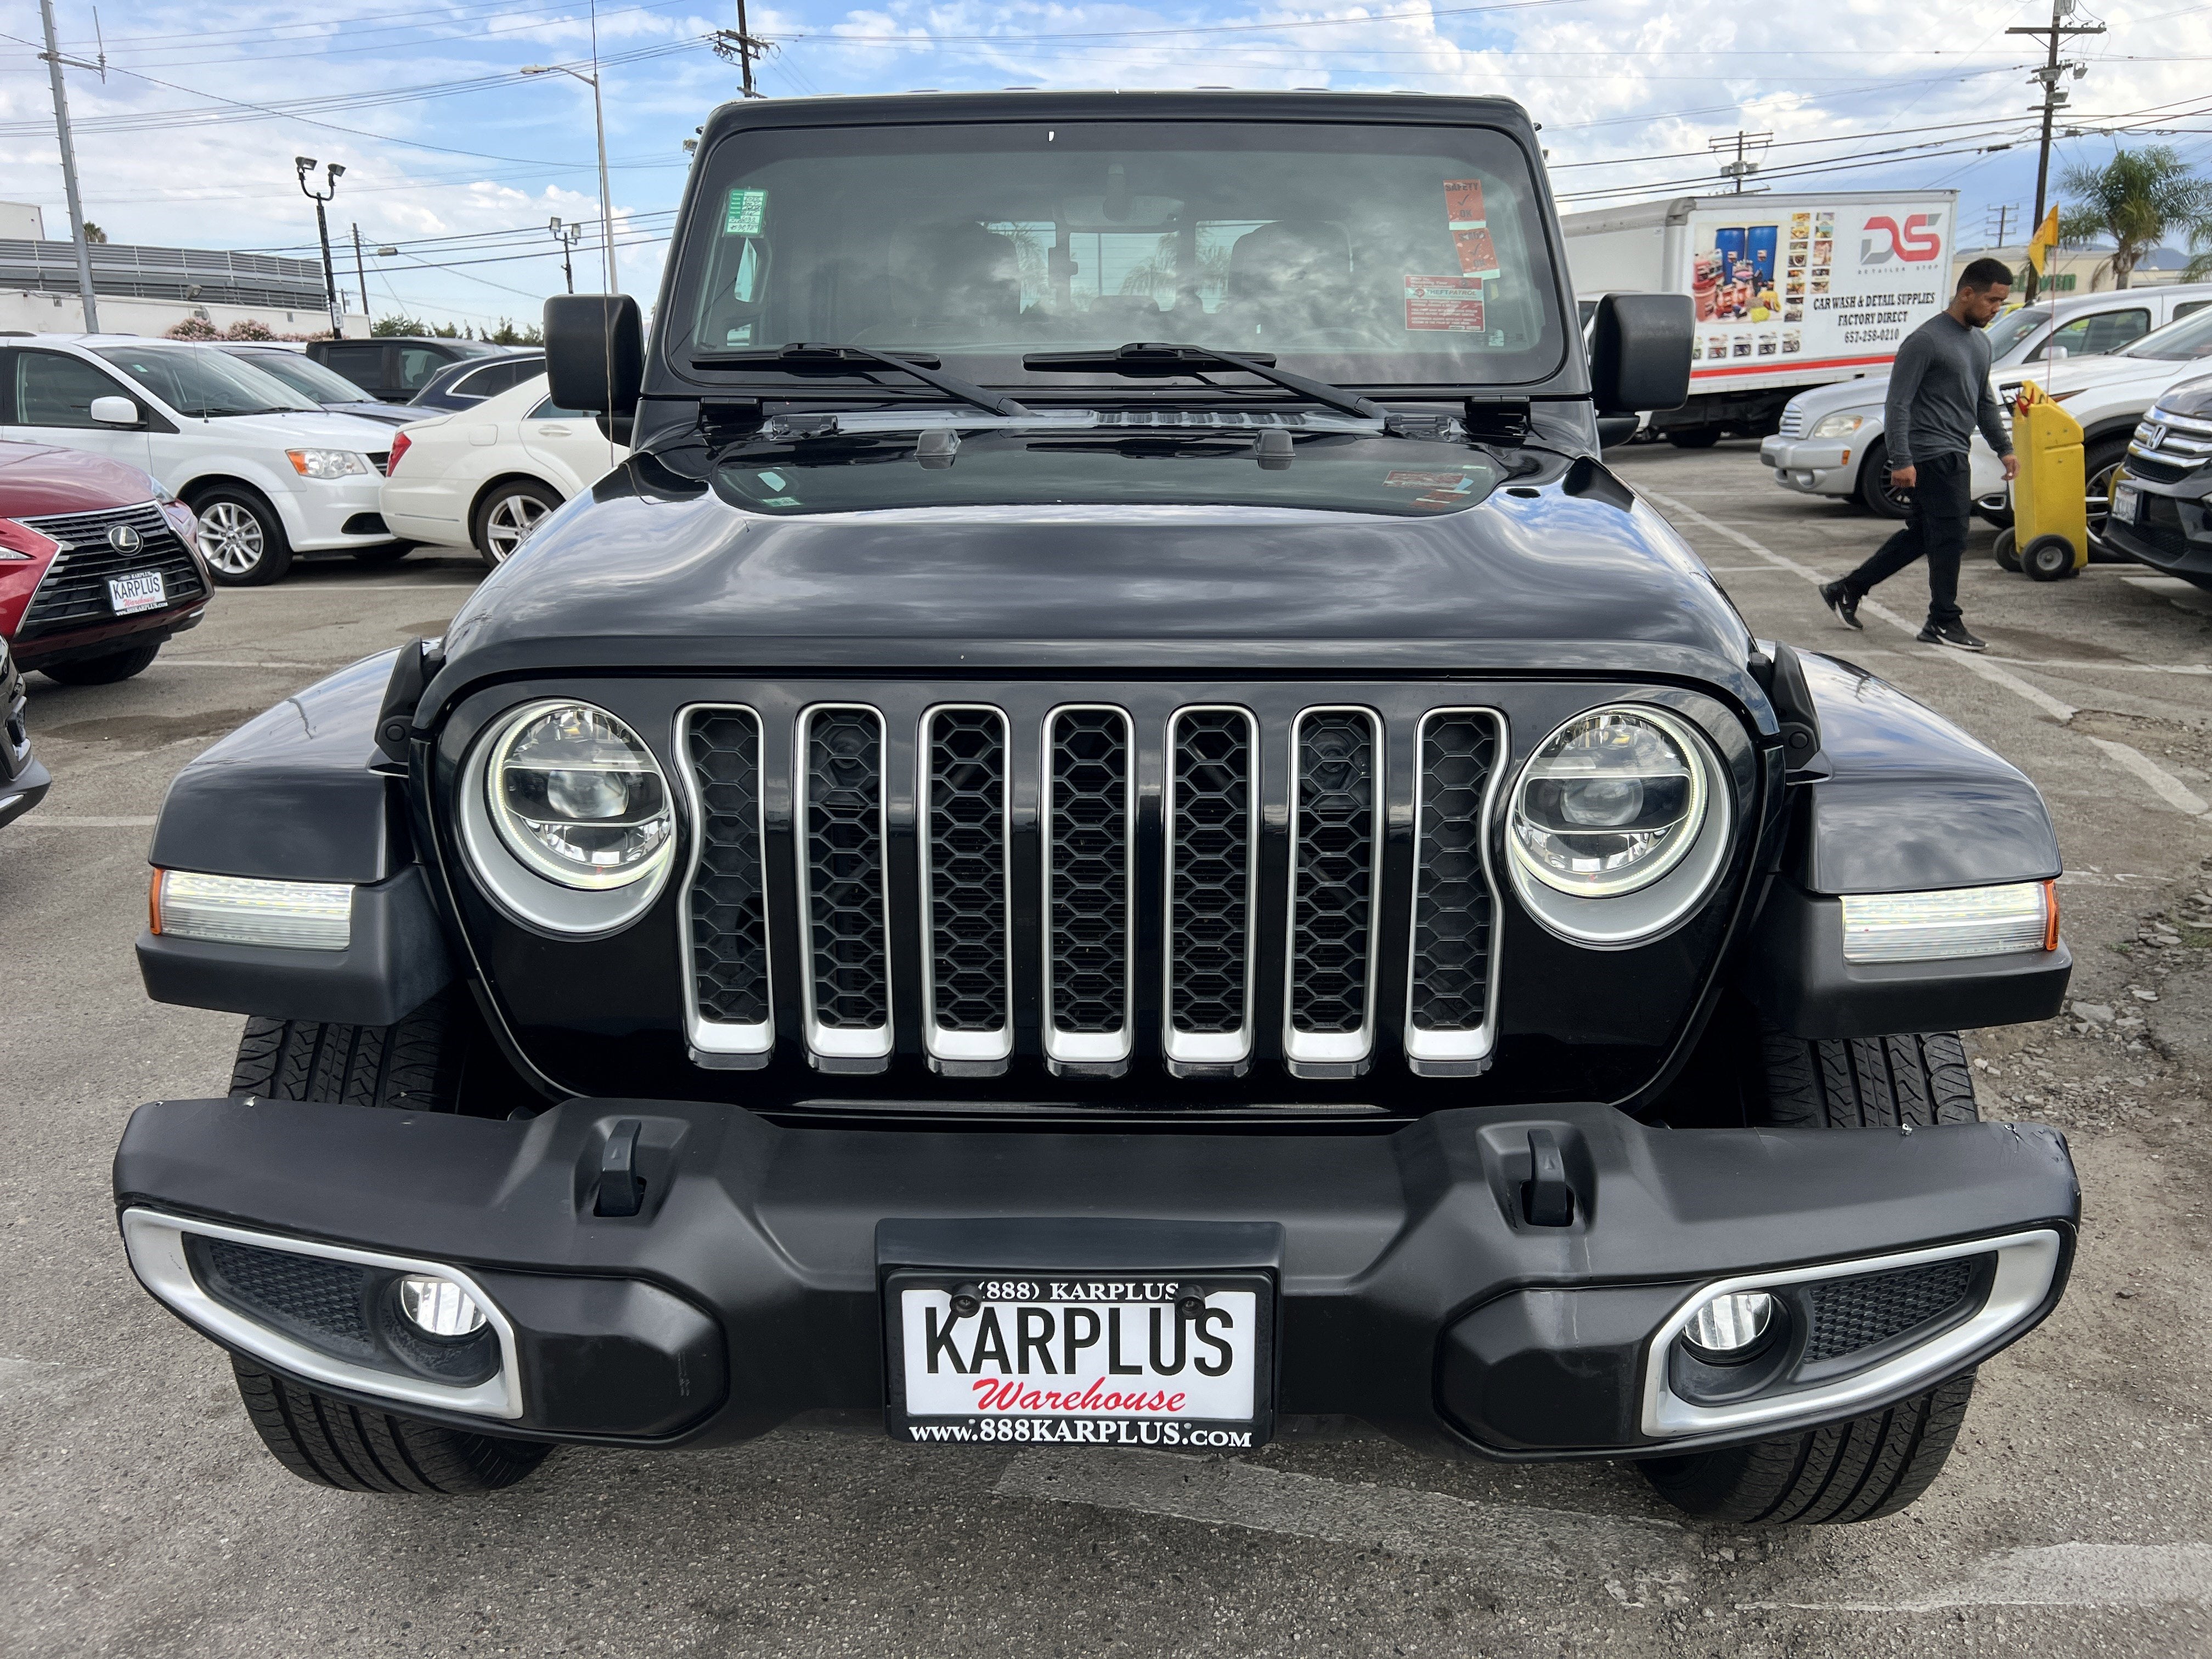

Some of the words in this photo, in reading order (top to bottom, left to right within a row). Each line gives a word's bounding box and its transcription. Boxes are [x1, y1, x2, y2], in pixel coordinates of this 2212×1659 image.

[1444, 182, 1478, 191] SAFETY
[1460, 210, 1472, 218] OK
[1813, 298, 1831, 311] CAR
[1832, 296, 1857, 309] WASH
[1858, 296, 1864, 307] &
[1866, 294, 1895, 307] DETAIL
[1897, 292, 1936, 306] SUPPLIES
[1838, 312, 1876, 326] FACTORY
[1877, 311, 1909, 324] DIRECT
[113, 577, 160, 600] KARPLUS
[1050, 1283, 1179, 1301] KARPLUS
[925, 1306, 1234, 1376] KARPLUS
[972, 1376, 1186, 1412] Warehouse
